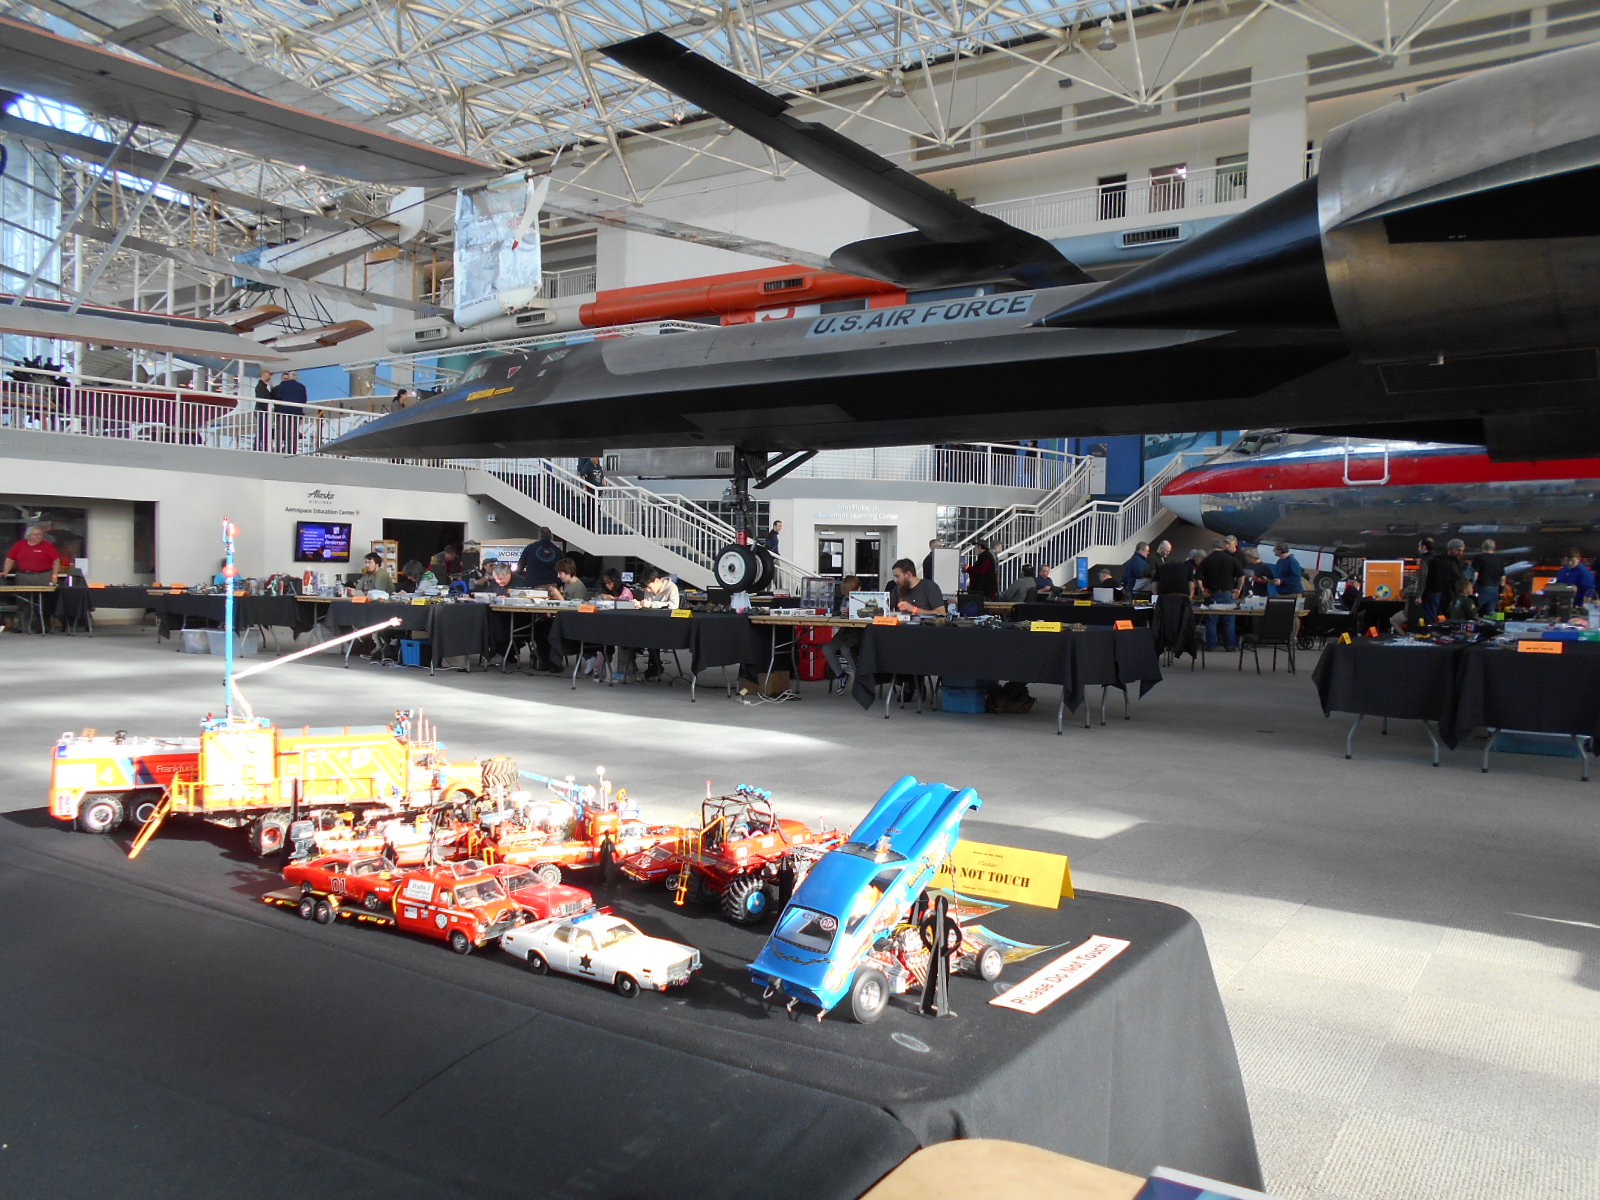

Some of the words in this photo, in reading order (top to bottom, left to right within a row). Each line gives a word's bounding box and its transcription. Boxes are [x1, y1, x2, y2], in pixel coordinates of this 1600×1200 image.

[921, 295, 1034, 323] FORCE
[307, 489, 336, 500] Alaska
[285, 507, 313, 515] Aerospace
[313, 508, 338, 516] Education
[99, 766, 113, 783] 4
[940, 864, 957, 875] DO
[960, 867, 985, 880] NOT
[988, 871, 1031, 888] TOUCH
[330, 877, 348, 896] 01
[1010, 982, 1054, 1006] Please
[1045, 971, 1069, 984] Do
[1062, 961, 1087, 974] Not
[1075, 943, 1112, 961] Touch
